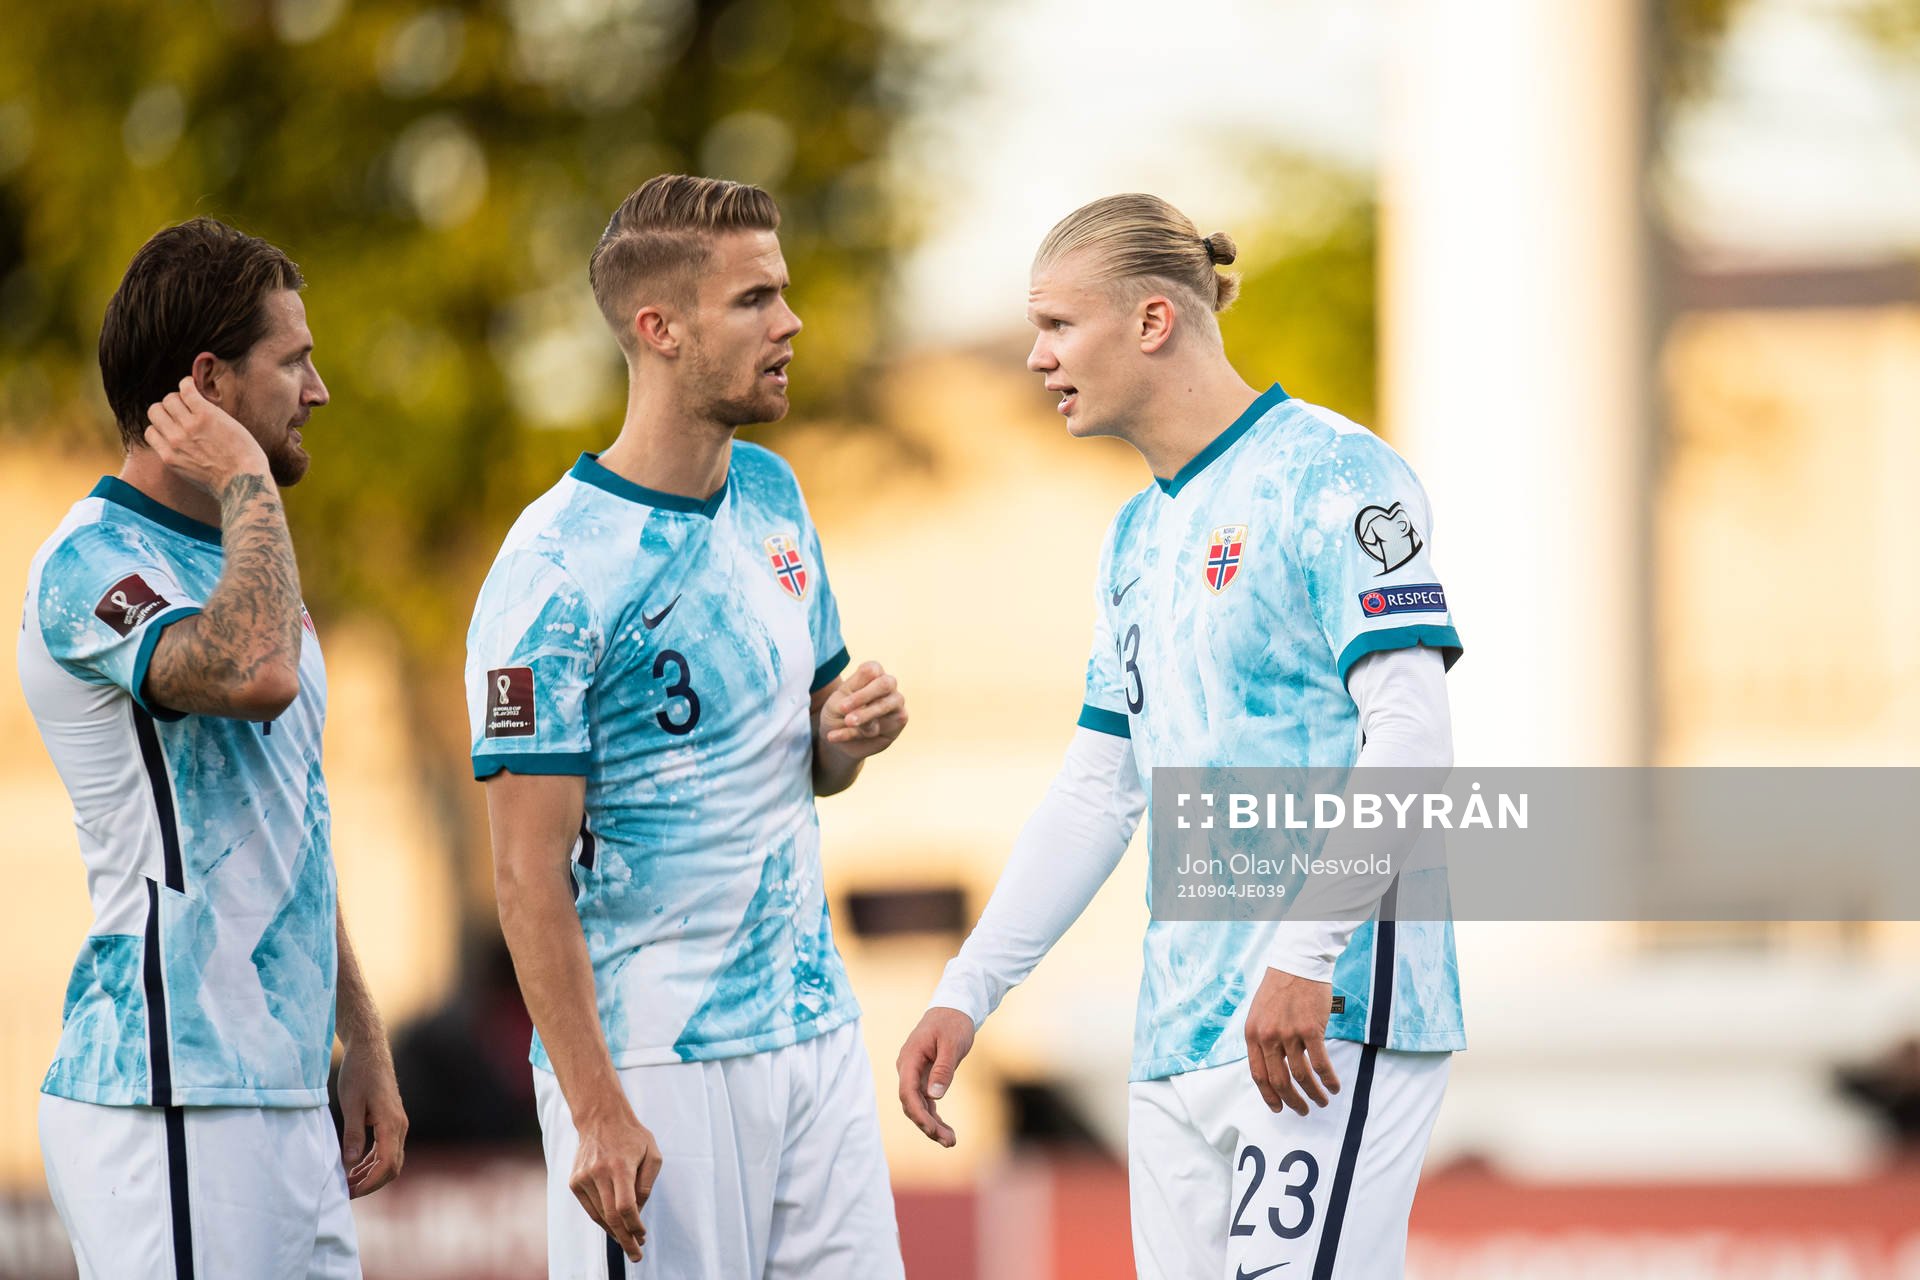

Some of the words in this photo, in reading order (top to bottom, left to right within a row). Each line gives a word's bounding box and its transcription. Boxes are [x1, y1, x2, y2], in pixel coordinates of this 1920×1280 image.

[1387, 591, 1444, 606] RESPECT
[652, 649, 701, 736] 3
[1116, 623, 1144, 715] 3
[1229, 1144, 1320, 1240] 23
